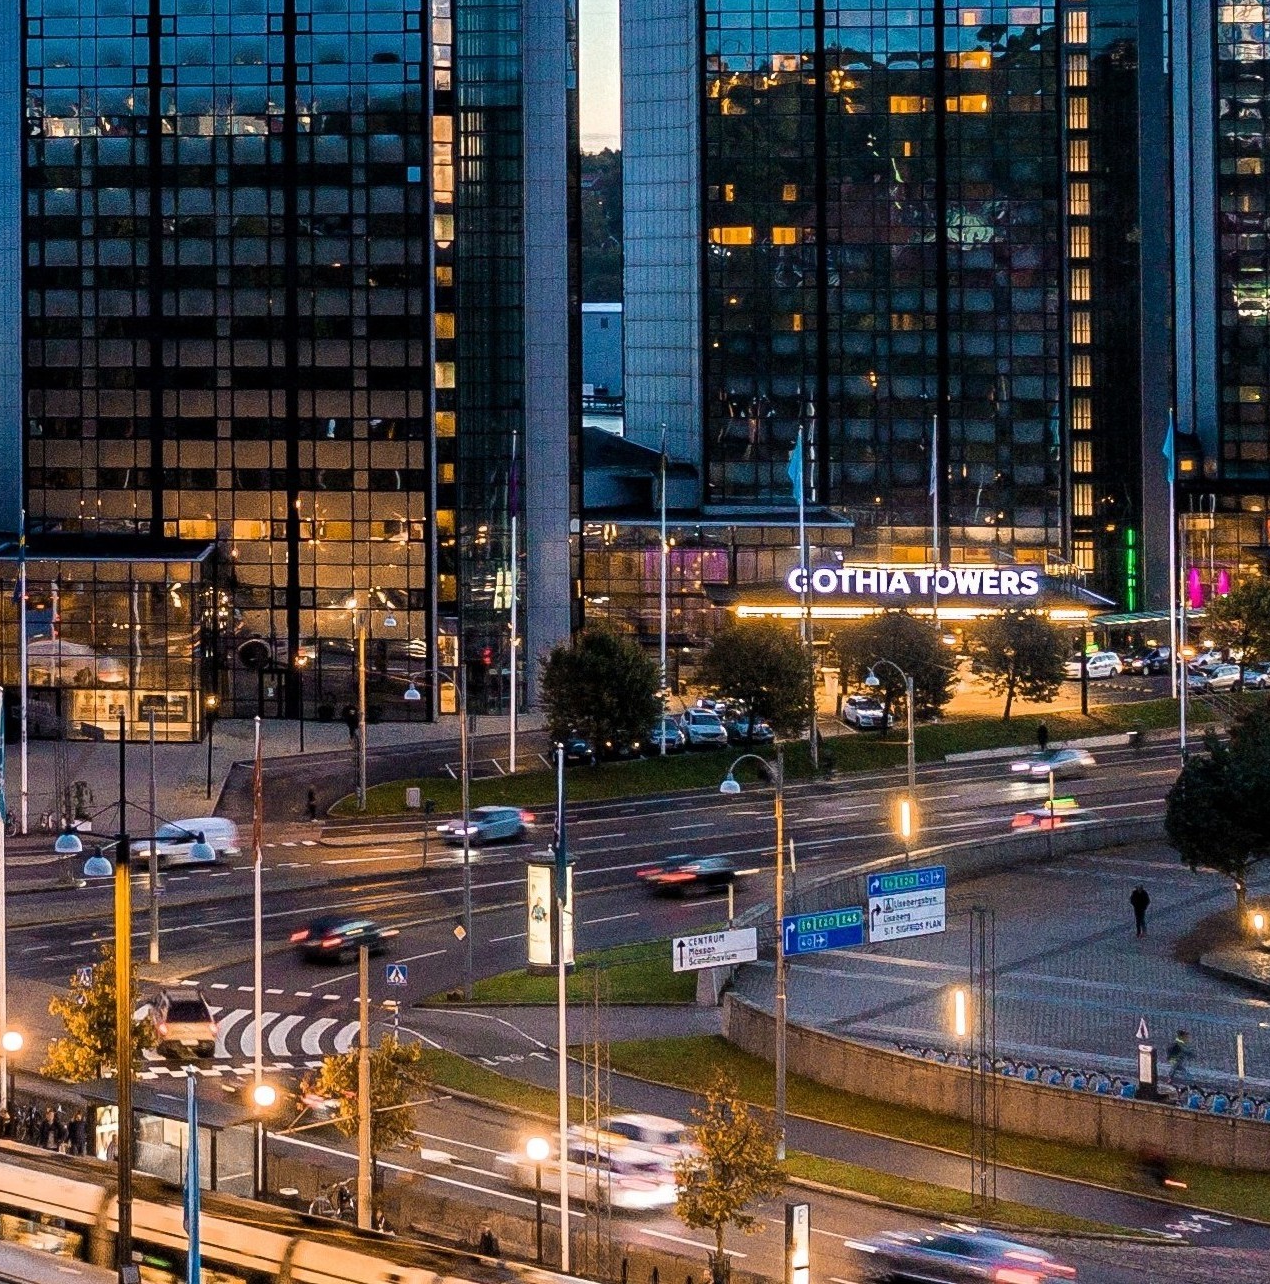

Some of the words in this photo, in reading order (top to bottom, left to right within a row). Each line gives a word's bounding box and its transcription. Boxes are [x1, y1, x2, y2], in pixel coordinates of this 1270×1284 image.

[788, 567, 912, 594] GOTHIA
[913, 568, 1040, 596] TOWERS
[818, 916, 835, 928] E20
[925, 919, 942, 929] PLAN
[689, 933, 725, 947] CENTRUM
